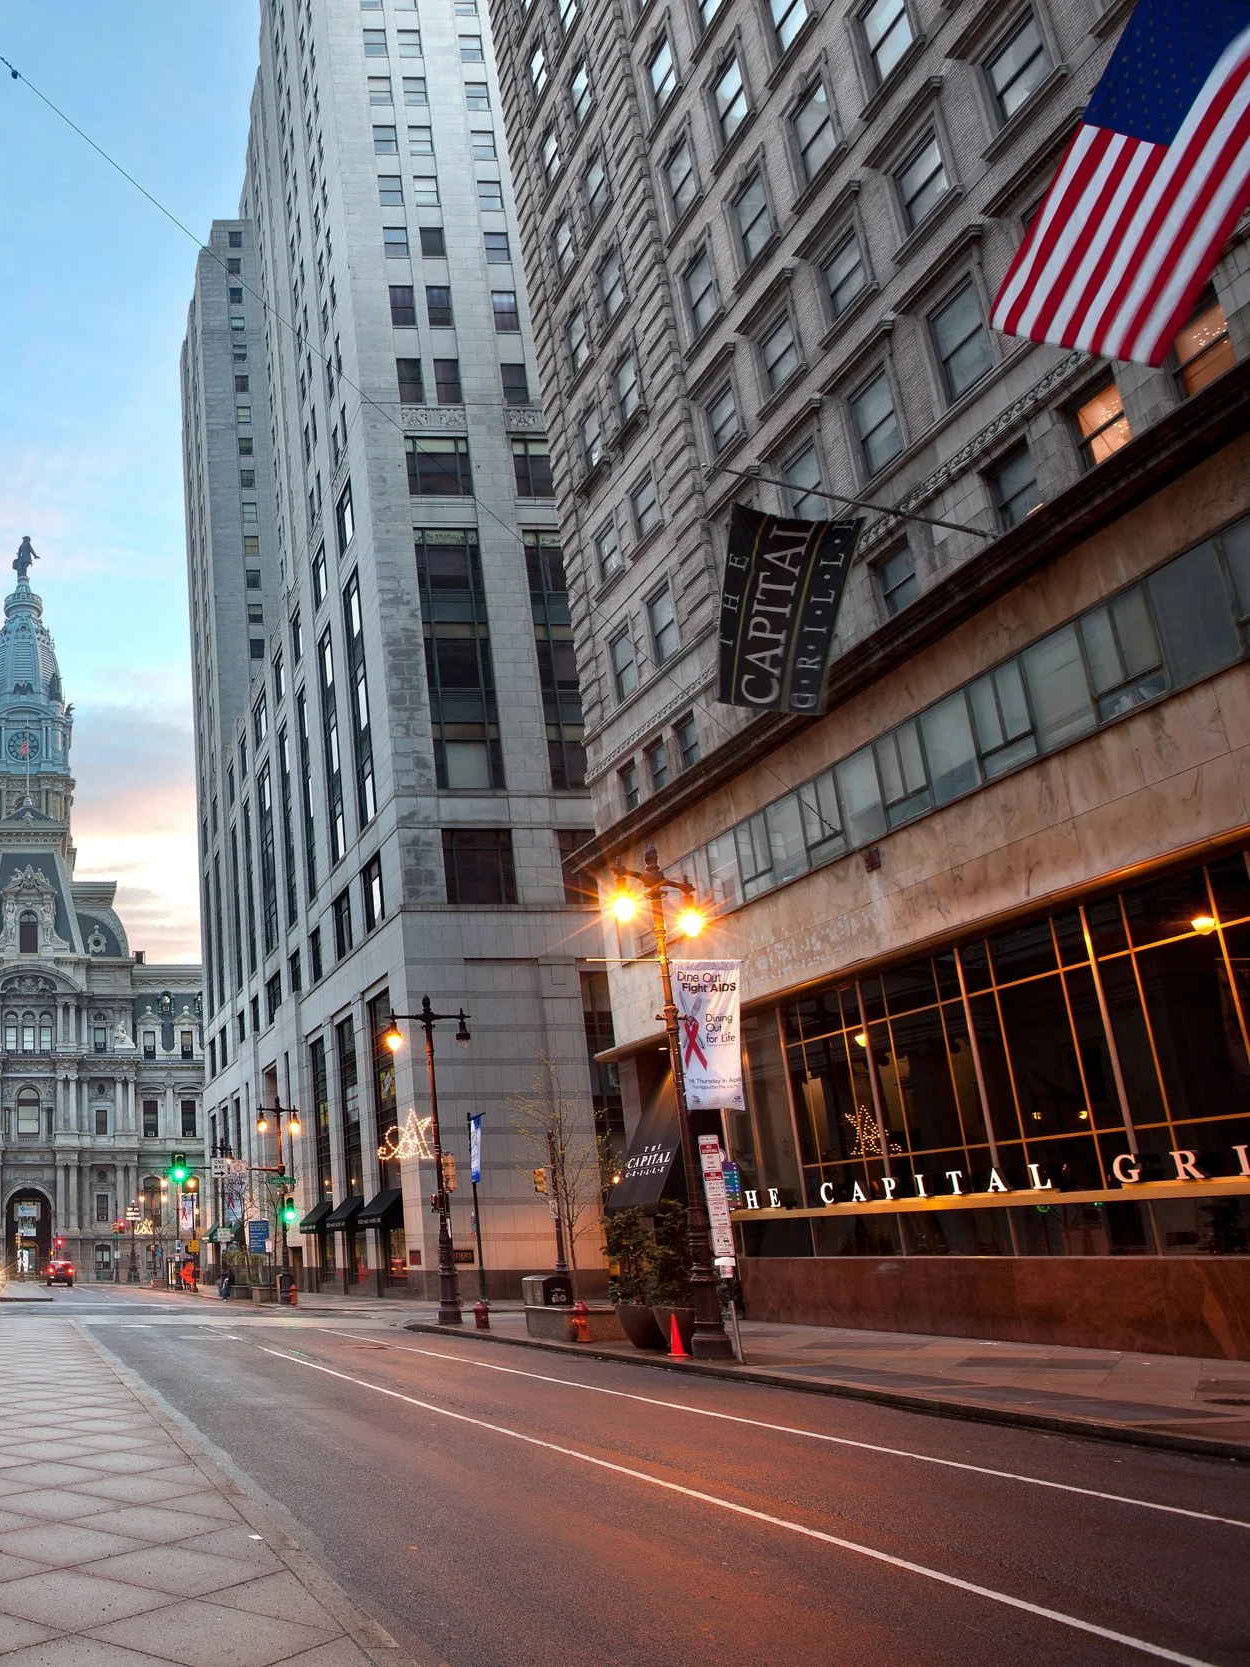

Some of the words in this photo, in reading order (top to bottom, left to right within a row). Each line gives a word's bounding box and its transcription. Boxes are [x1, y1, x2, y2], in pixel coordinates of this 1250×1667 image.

[677, 971, 700, 983] Dine
[702, 972, 722, 983] Out
[682, 983, 708, 995] Fight
[709, 983, 737, 993] AIDS
[705, 1013, 734, 1024] Dining
[705, 1023, 723, 1033] Out
[706, 1033, 719, 1044] for
[721, 1032, 736, 1043] Life
[627, 1151, 671, 1169] CAPITAL
[744, 1188, 781, 1210] HE
[819, 1163, 1053, 1204] CAPITAL
